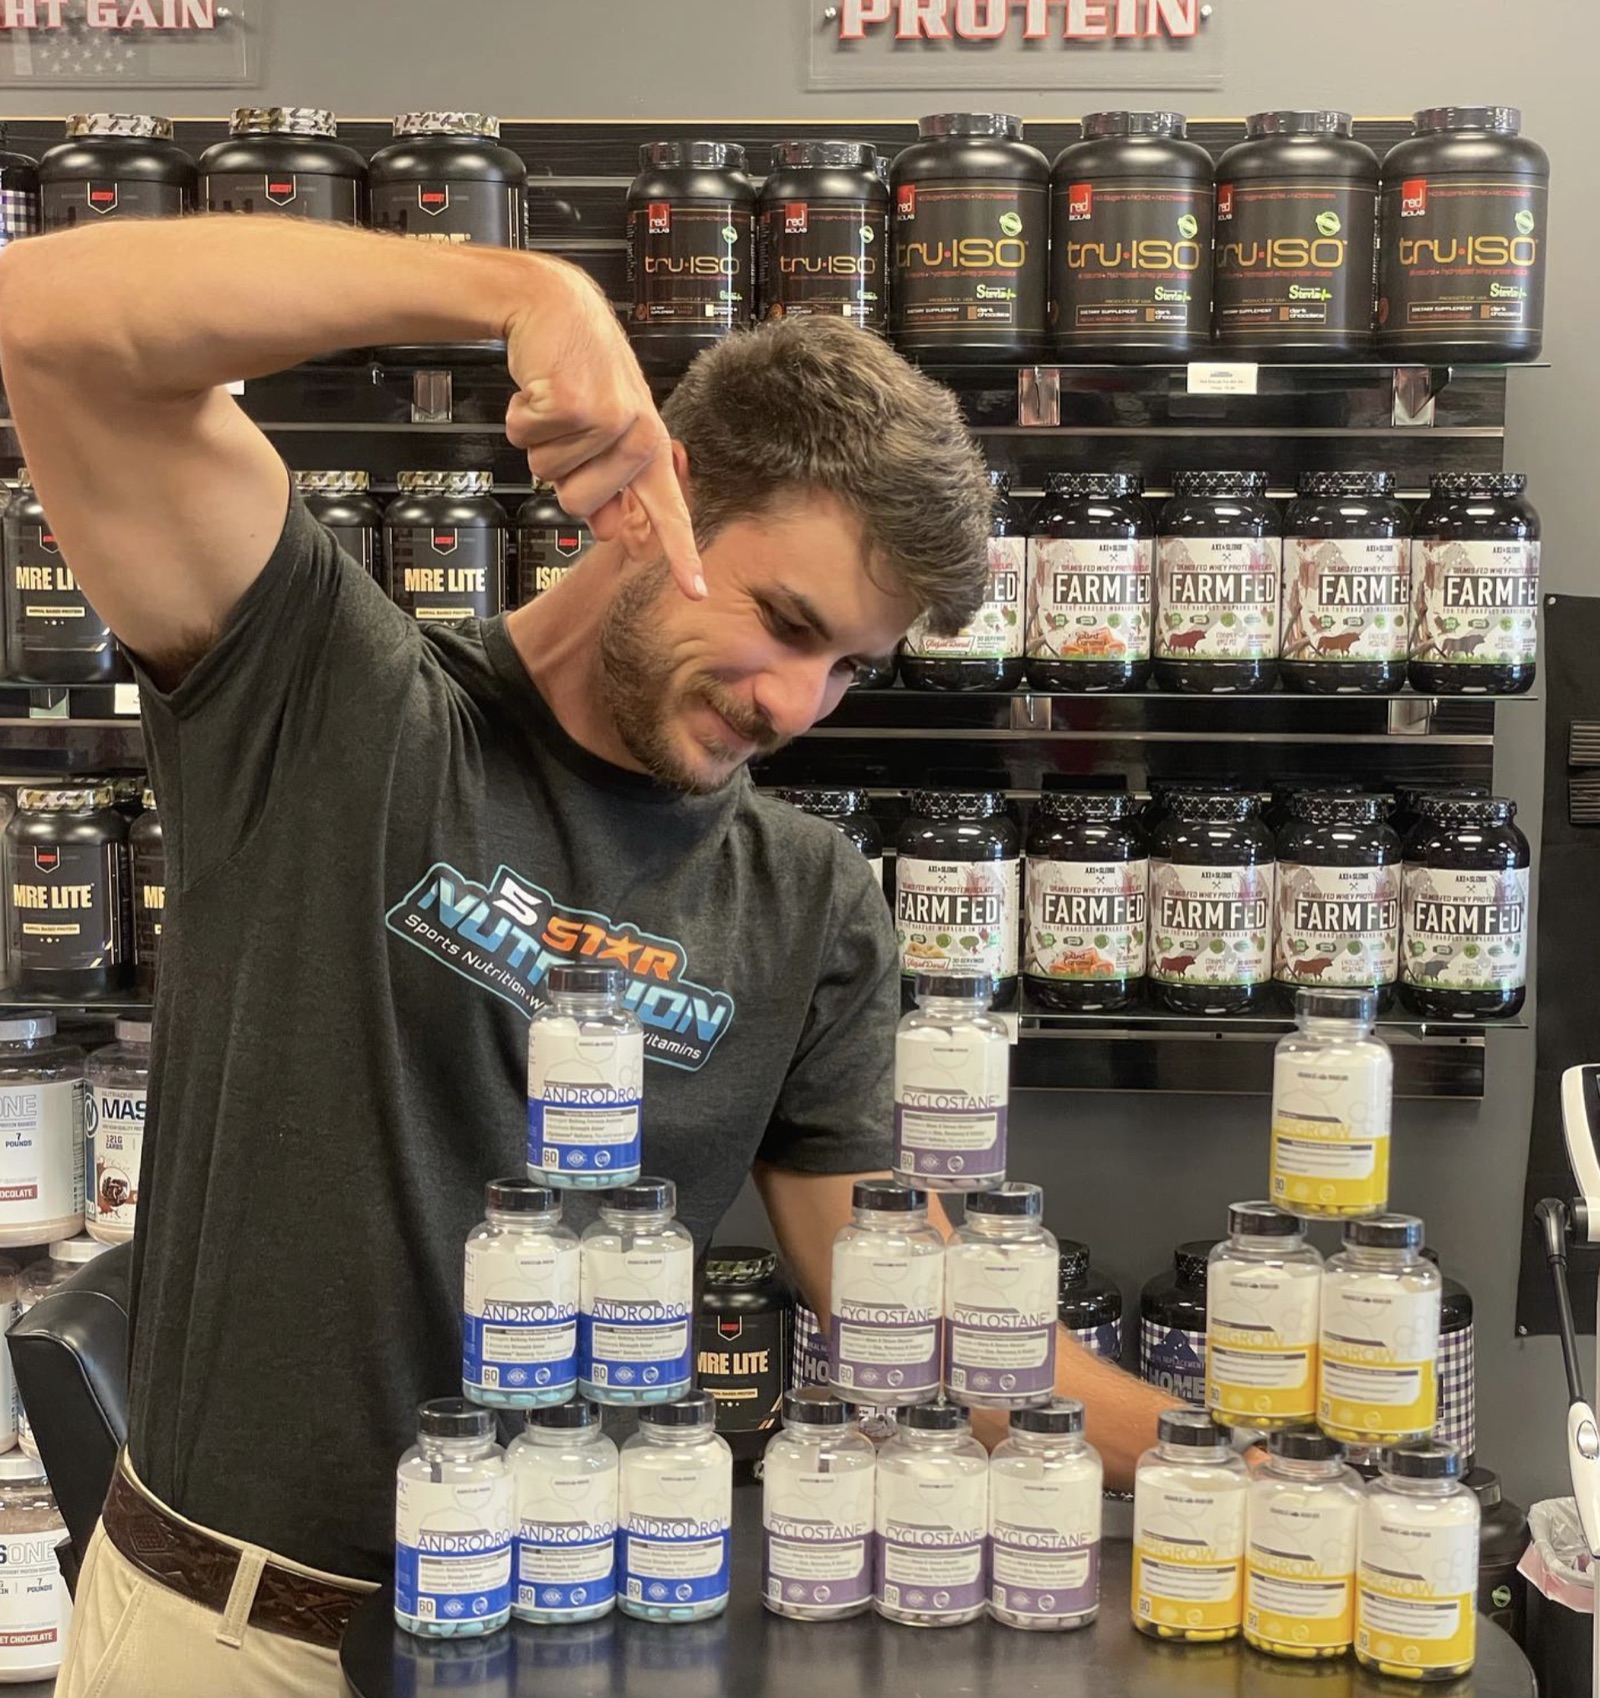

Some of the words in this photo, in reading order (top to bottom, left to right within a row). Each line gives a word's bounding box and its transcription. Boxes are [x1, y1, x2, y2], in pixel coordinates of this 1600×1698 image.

[86, 0, 215, 29] GAIN
[838, 0, 1200, 39] PROTEIN
[16, 566, 52, 590] MRE
[57, 567, 82, 590] LI
[404, 568, 444, 592] MRE
[448, 568, 486, 592] LITE
[1056, 574, 1121, 604] FARM
[1172, 574, 1235, 603] FARM
[1241, 574, 1275, 603] FED
[1321, 576, 1386, 604] FARM
[1447, 577, 1513, 606] FARM
[13, 883, 48, 908] MRE
[52, 883, 92, 909] LITE
[493, 877, 543, 926] 5
[899, 891, 949, 924] FARM
[956, 896, 998, 924] FED
[1045, 895, 1108, 924] FARM
[1113, 895, 1144, 924] FED
[1163, 899, 1224, 929] FARM
[1230, 900, 1265, 930] FED
[1297, 901, 1361, 931] FARM
[1367, 901, 1396, 930] FED
[1416, 902, 1478, 934] FARM
[1485, 904, 1520, 934] FED
[404, 914, 461, 956] Sports
[902, 1092, 996, 1109] CYCLOSTANE
[544, 1149, 557, 1163] 60
[840, 1305, 935, 1323] CYCLOSTANE
[953, 1310, 1047, 1327] CYCLOSTANE
[593, 1366, 607, 1379] 60
[733, 1350, 769, 1374] LITE
[841, 1368, 852, 1380] 60
[484, 1369, 498, 1382] 60
[952, 1371, 965, 1383] 60
[769, 1519, 863, 1540] CYCLOSTANE
[886, 1526, 980, 1545] CYCLOSTANE
[994, 1527, 1088, 1548] CYCLOSTANE
[27, 1584, 52, 1593] POUNDS
[520, 1587, 533, 1600] 60
[628, 1580, 641, 1594] 60
[419, 1602, 434, 1612] 60
[10, 1632, 52, 1644] CHOCOLATE
